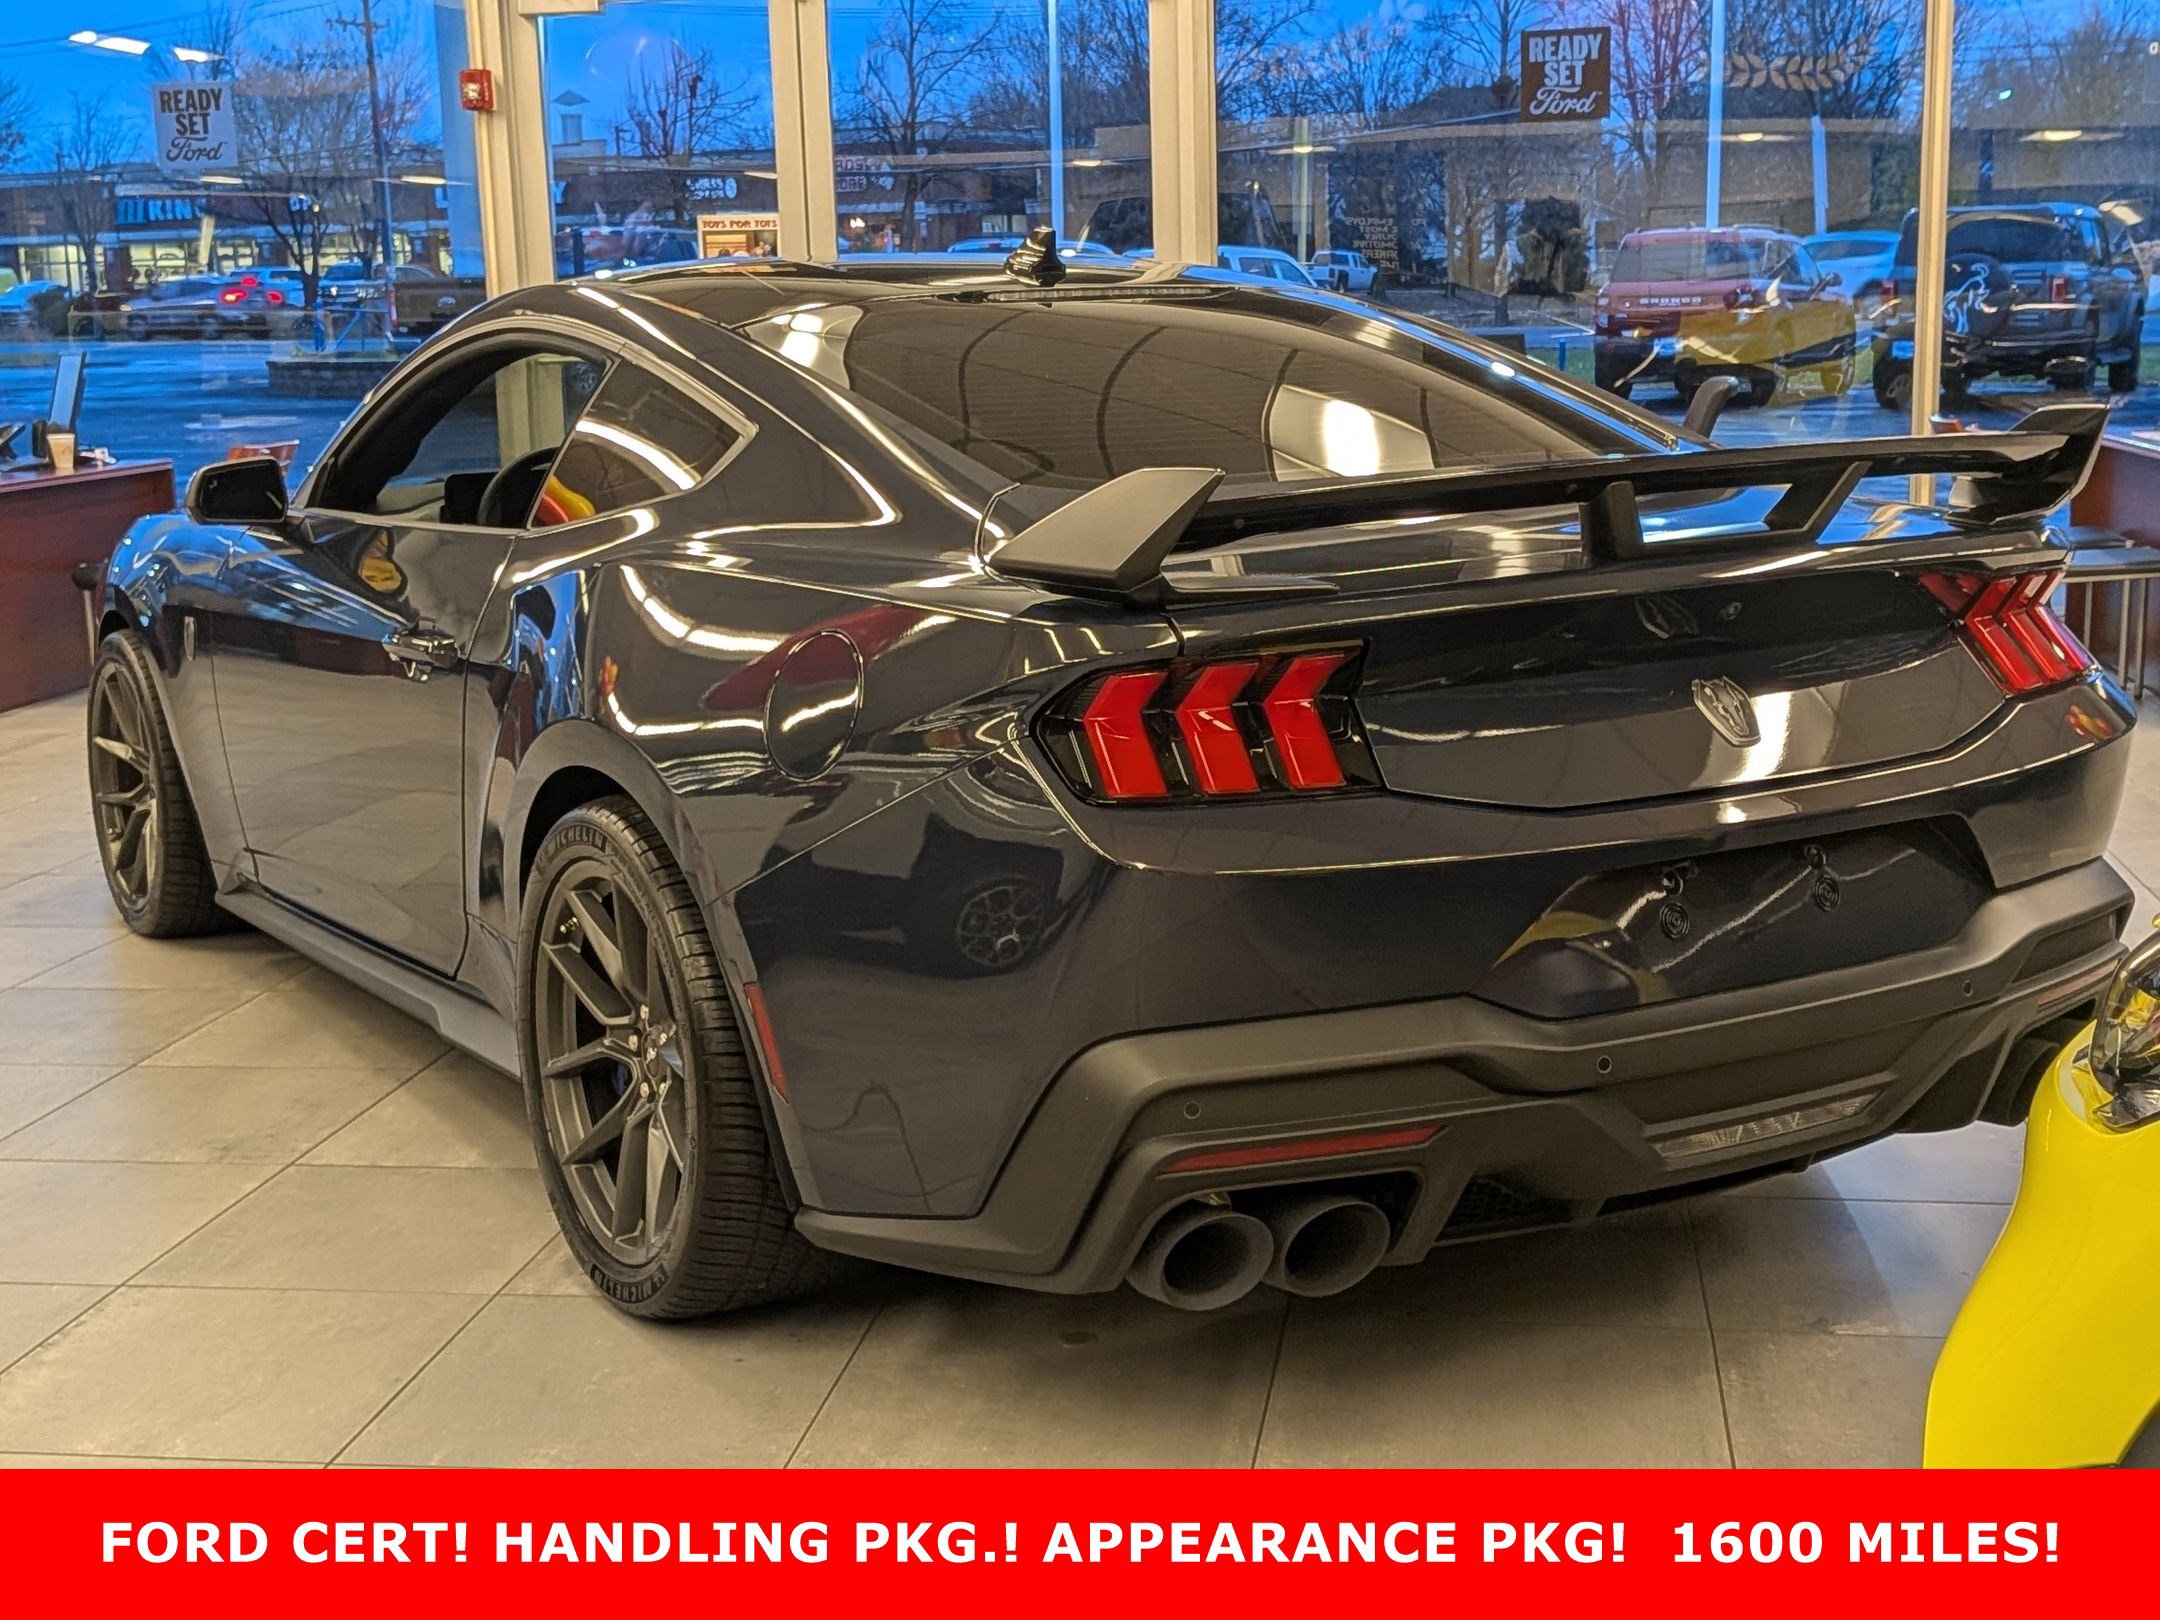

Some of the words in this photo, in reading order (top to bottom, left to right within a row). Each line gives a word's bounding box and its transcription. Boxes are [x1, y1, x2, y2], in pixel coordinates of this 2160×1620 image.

[1529, 33, 1602, 63] READY
[1544, 60, 1585, 87] SET
[160, 88, 222, 113] READY
[1529, 87, 1597, 115] Ford
[175, 113, 210, 136] SET
[166, 136, 224, 161] Ford
[702, 220, 727, 229] TOYS
[730, 220, 751, 229] FOR
[754, 219, 778, 228] TOTS
[594, 1268, 653, 1302] MICHELIN
